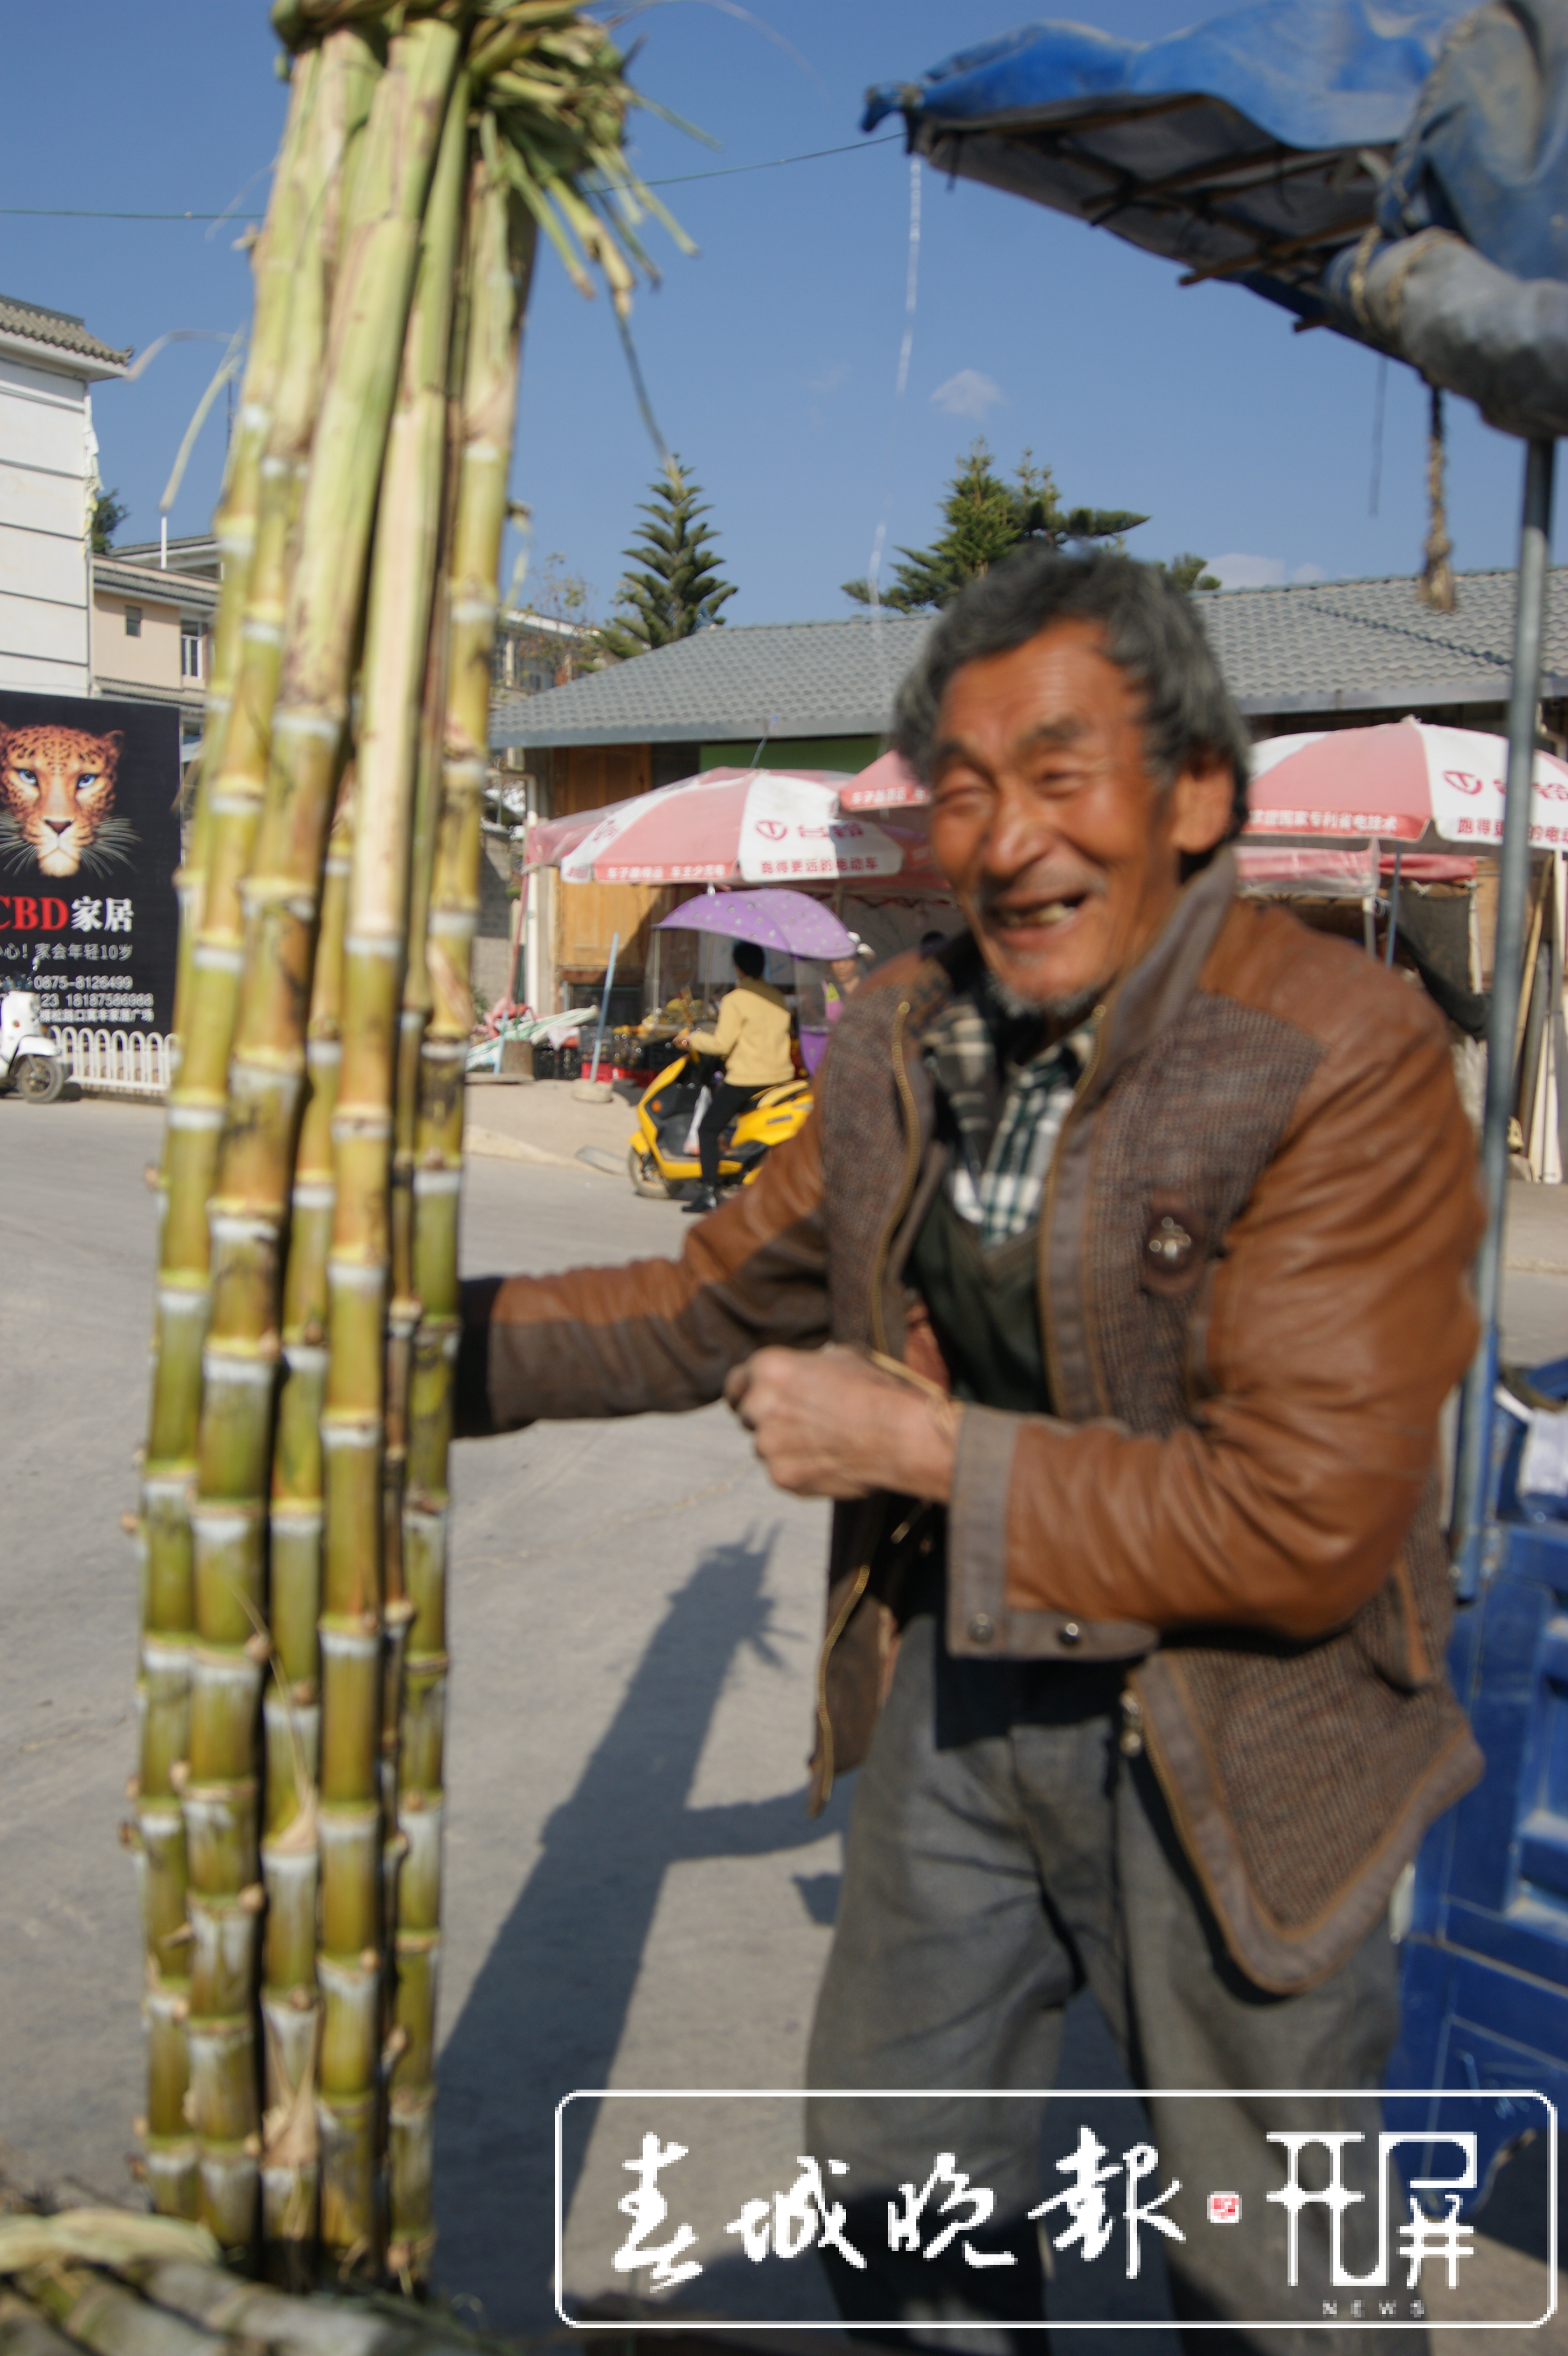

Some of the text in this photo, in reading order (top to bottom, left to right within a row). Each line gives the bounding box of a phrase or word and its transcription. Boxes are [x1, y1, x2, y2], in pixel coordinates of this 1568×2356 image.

[761, 856, 879, 874] 跑得更远的电动车
[33, 975, 133, 990] 0875-8126499
[66, 993, 154, 1008] 18187586988
